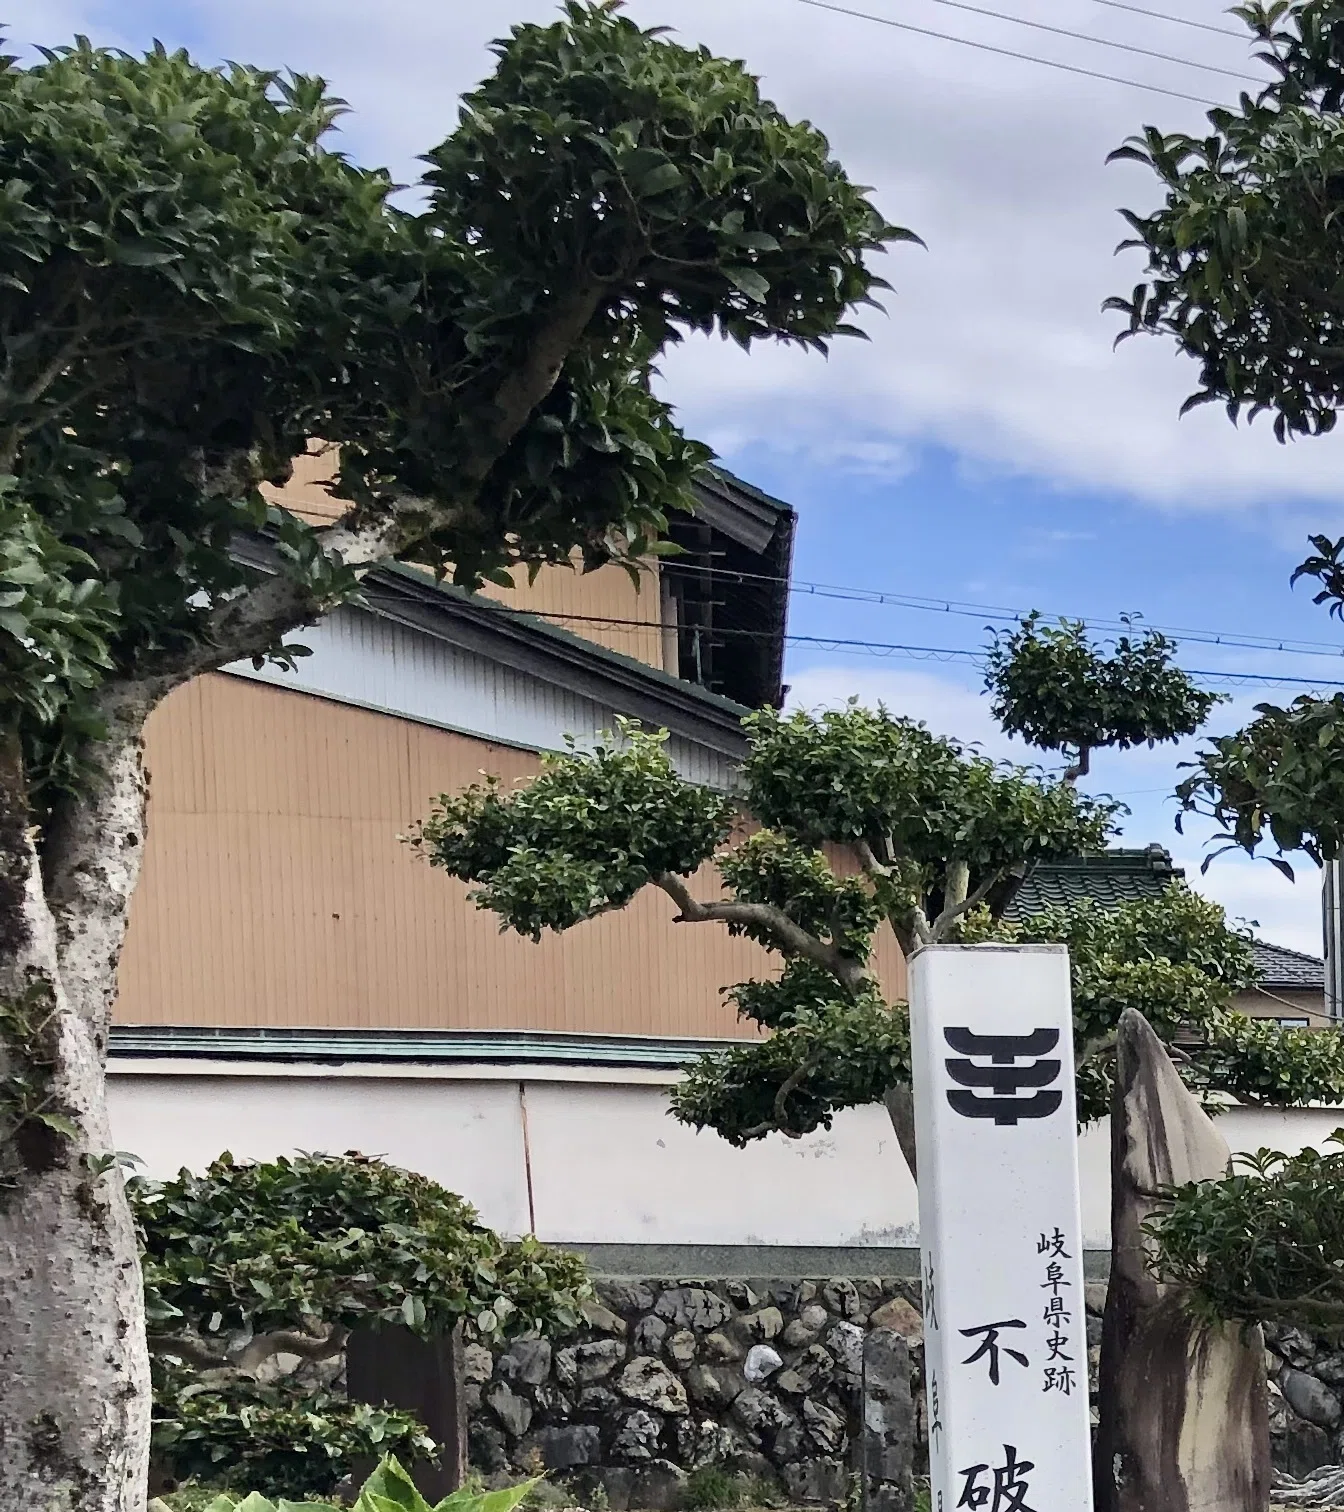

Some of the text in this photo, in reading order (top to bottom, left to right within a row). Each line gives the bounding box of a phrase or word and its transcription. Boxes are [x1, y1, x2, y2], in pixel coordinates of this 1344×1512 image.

[1037, 1227, 1077, 1396] 岐阜県史跡
